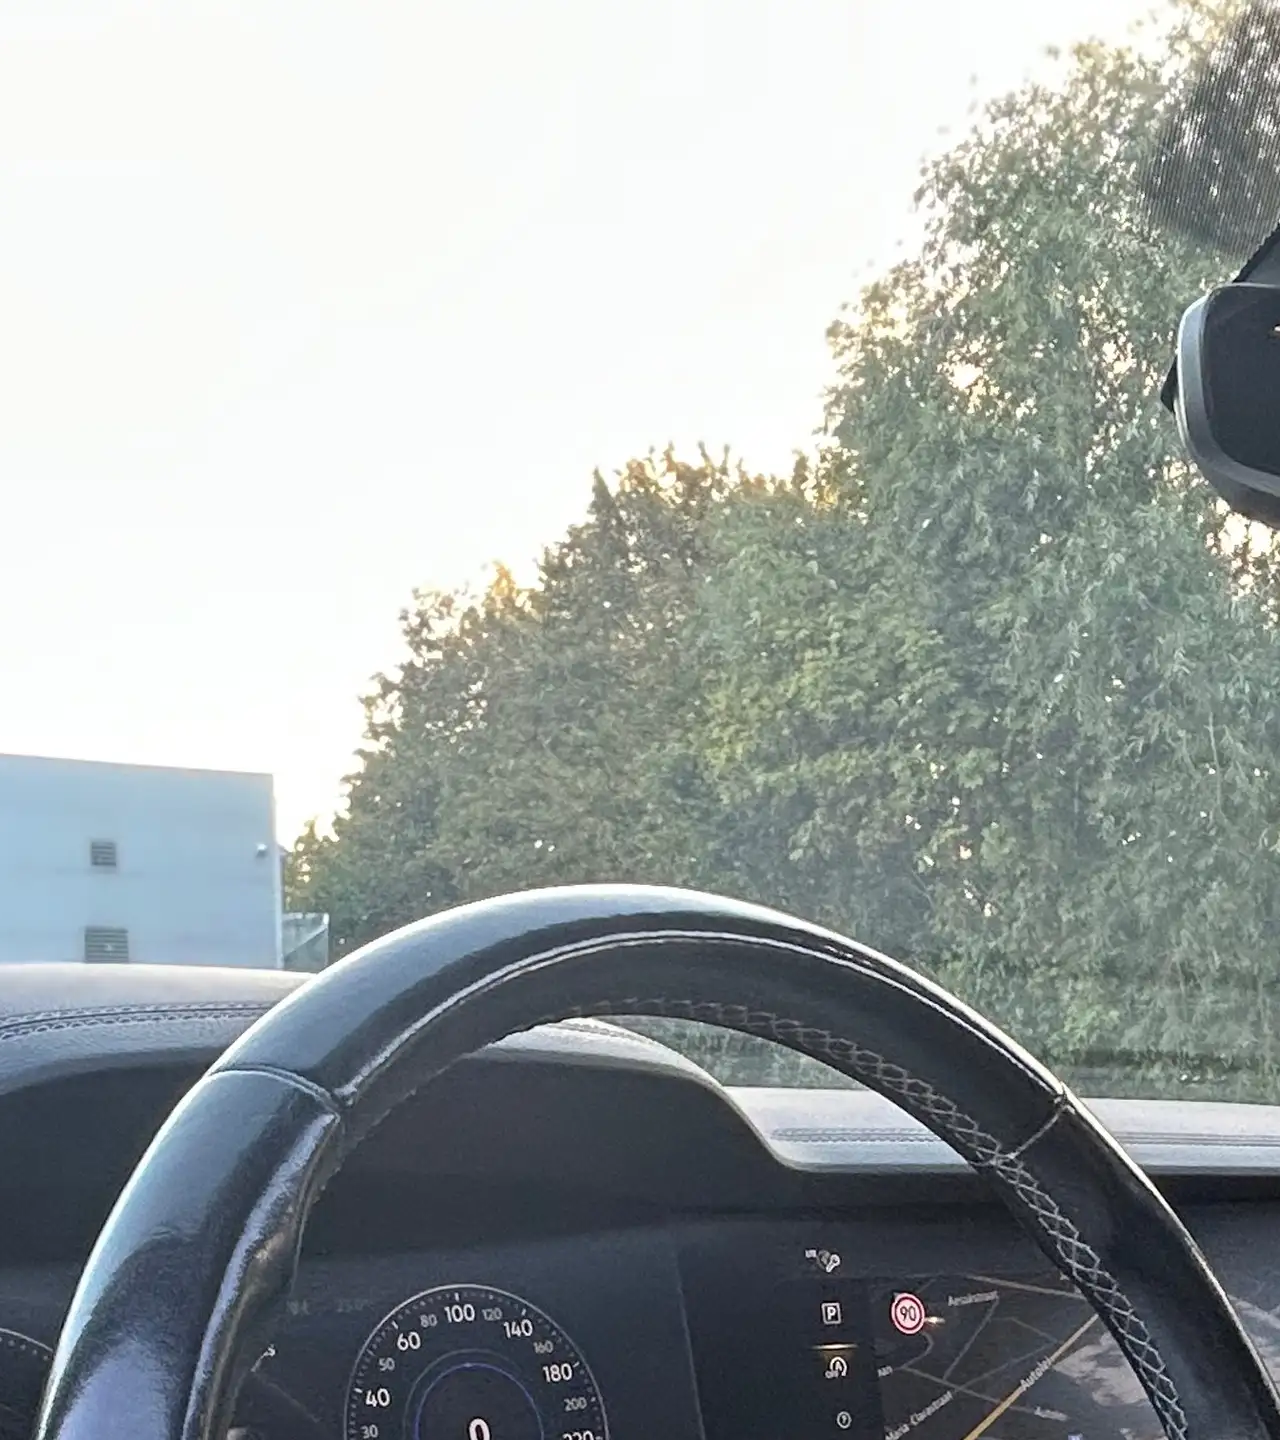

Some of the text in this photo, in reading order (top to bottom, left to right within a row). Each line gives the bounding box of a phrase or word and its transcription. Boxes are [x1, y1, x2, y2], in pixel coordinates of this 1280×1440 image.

[420, 1313, 438, 1329] 80
[444, 1303, 475, 1323] 100
[482, 1307, 503, 1322] 120
[900, 1305, 917, 1322] 90
[504, 1319, 534, 1339] 140
[397, 1331, 421, 1351] 60
[533, 1339, 555, 1355] 160
[378, 1357, 395, 1372] 50
[543, 1362, 573, 1383] 180
[366, 1388, 390, 1407] 40
[564, 1396, 588, 1412] 200
[361, 1424, 379, 1439] 30
